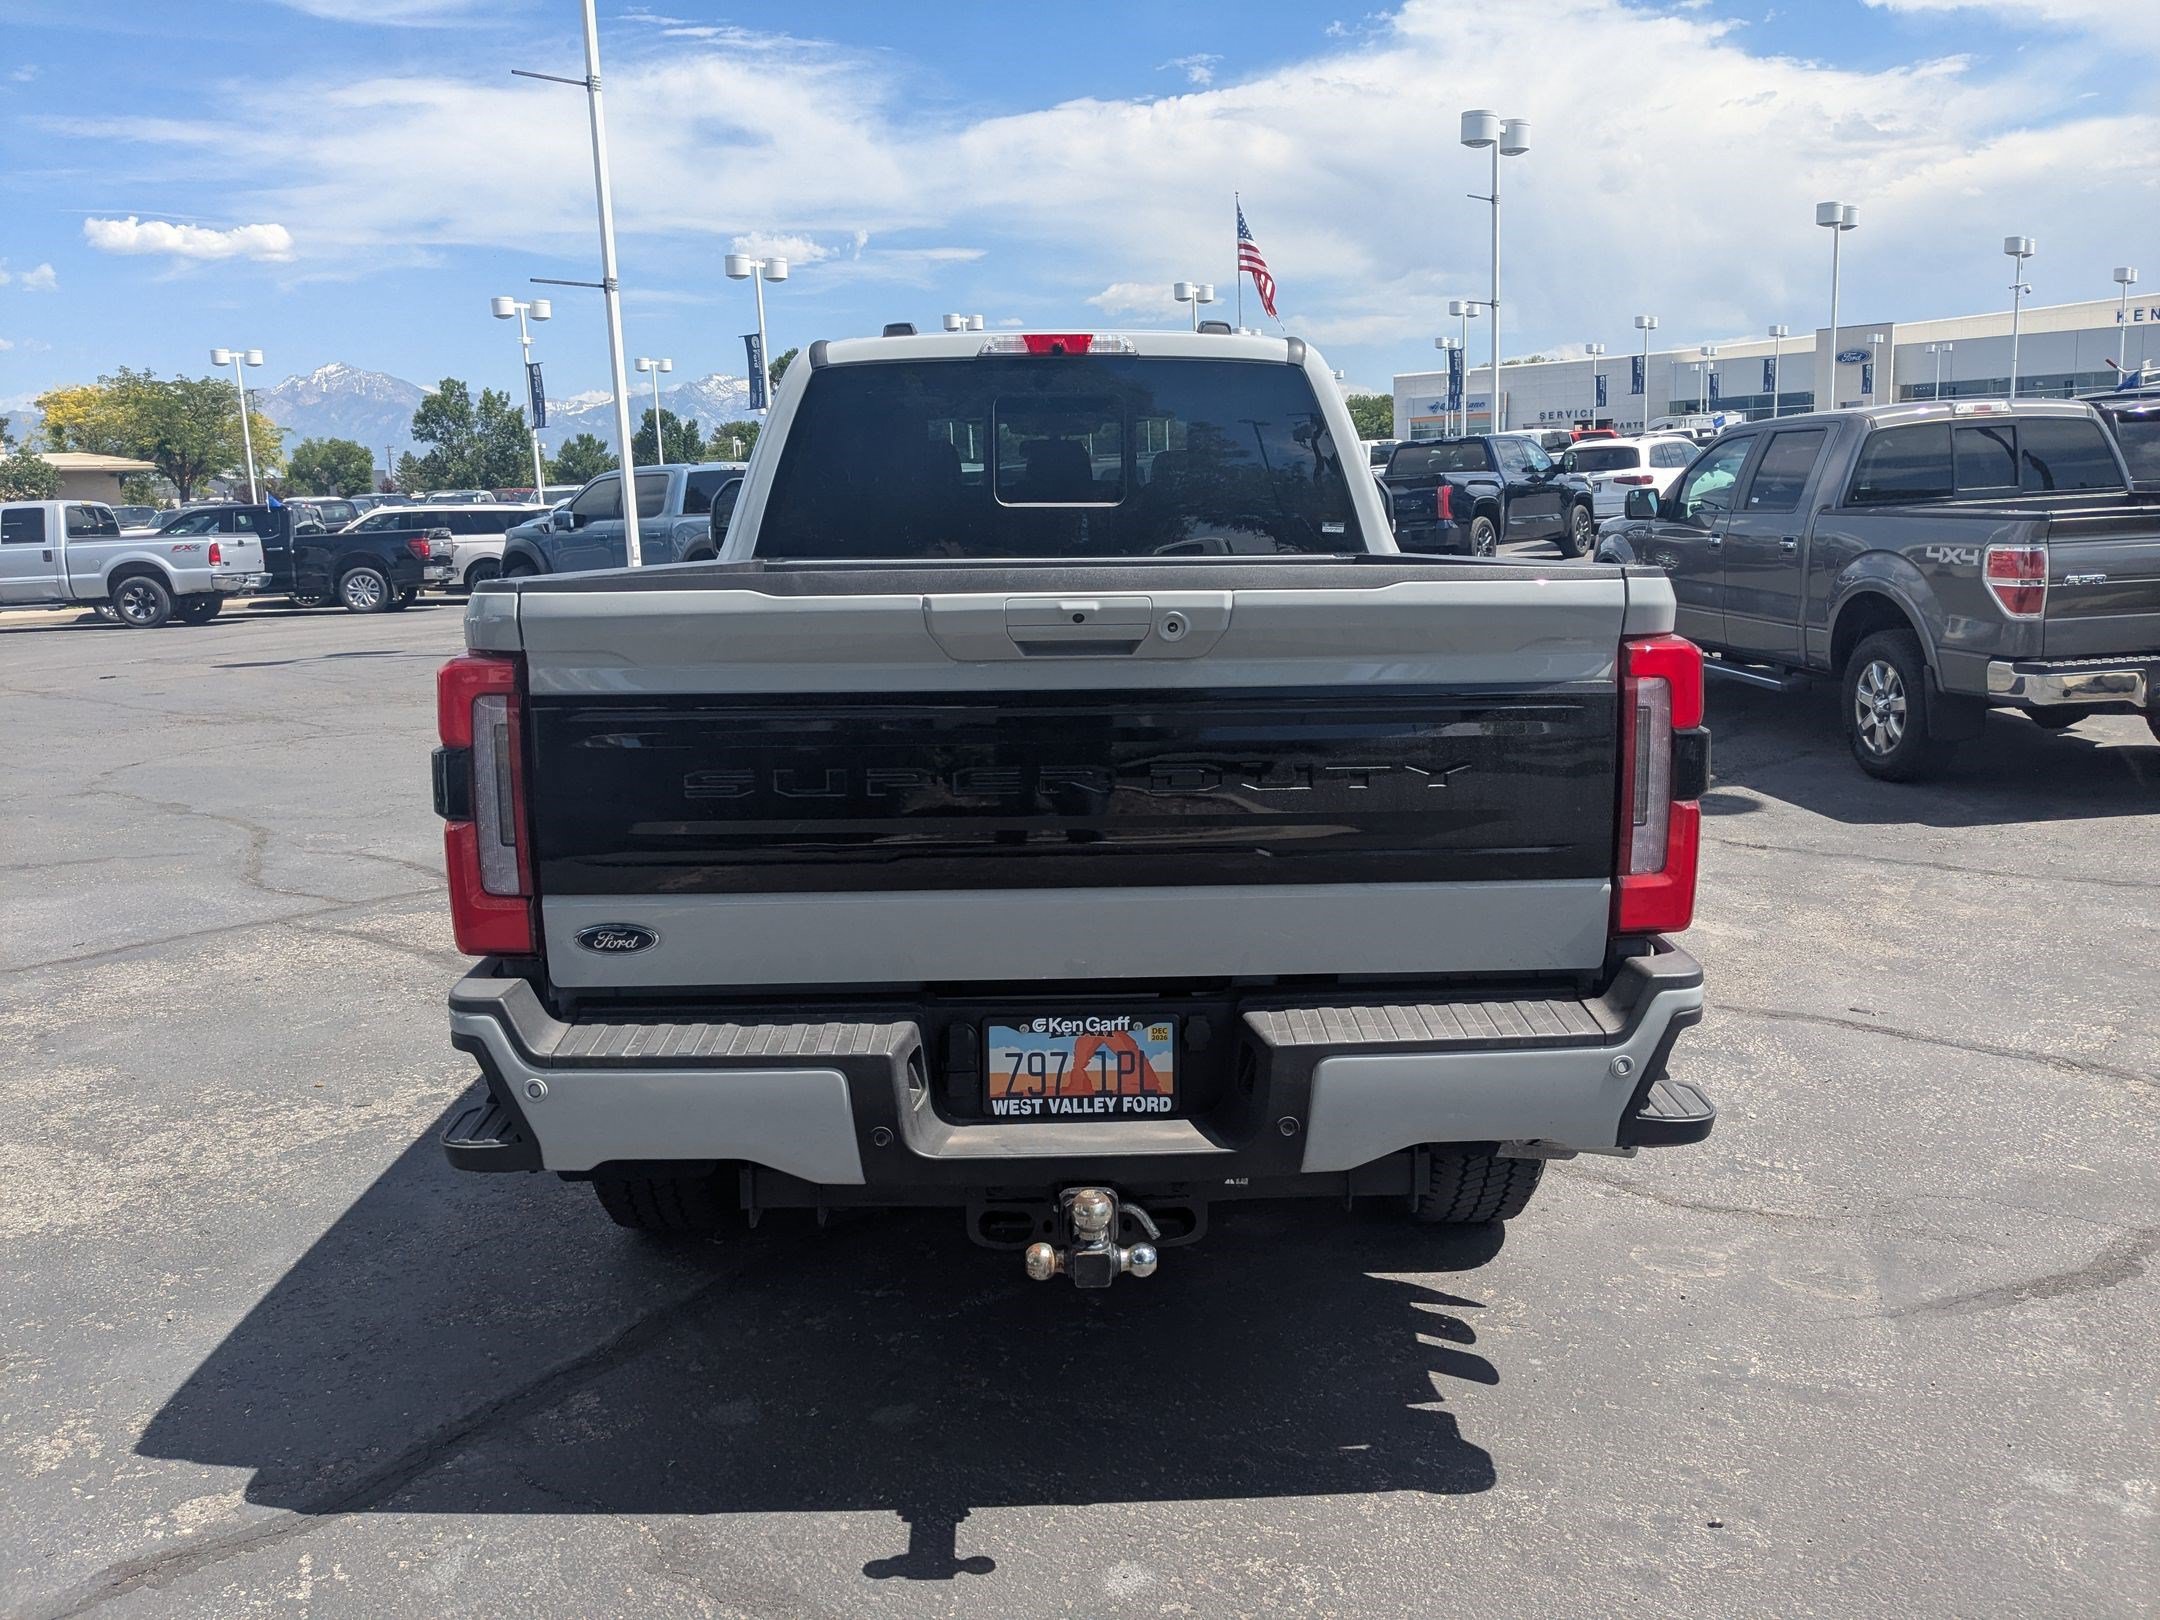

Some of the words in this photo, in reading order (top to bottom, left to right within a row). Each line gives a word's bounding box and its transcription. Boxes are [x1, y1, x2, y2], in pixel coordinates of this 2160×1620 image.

[1841, 352, 1862, 362] Ford
[1540, 409, 1595, 420] SERVICE
[1613, 421, 1645, 429] PARTS
[683, 767, 1112, 799] SUPER
[1149, 763, 1472, 793] DUTY
[593, 930, 639, 949] Ford
[1049, 1017, 1083, 1033] Ken
[1085, 1016, 1131, 1033] Garff
[1151, 1027, 1168, 1035] DEC
[1005, 1051, 1069, 1096] Z97
[1094, 1050, 1158, 1095] 1PL
[992, 1098, 1044, 1115] WEST
[1048, 1097, 1118, 1114] VALLEY
[1123, 1096, 1172, 1113] FORD
